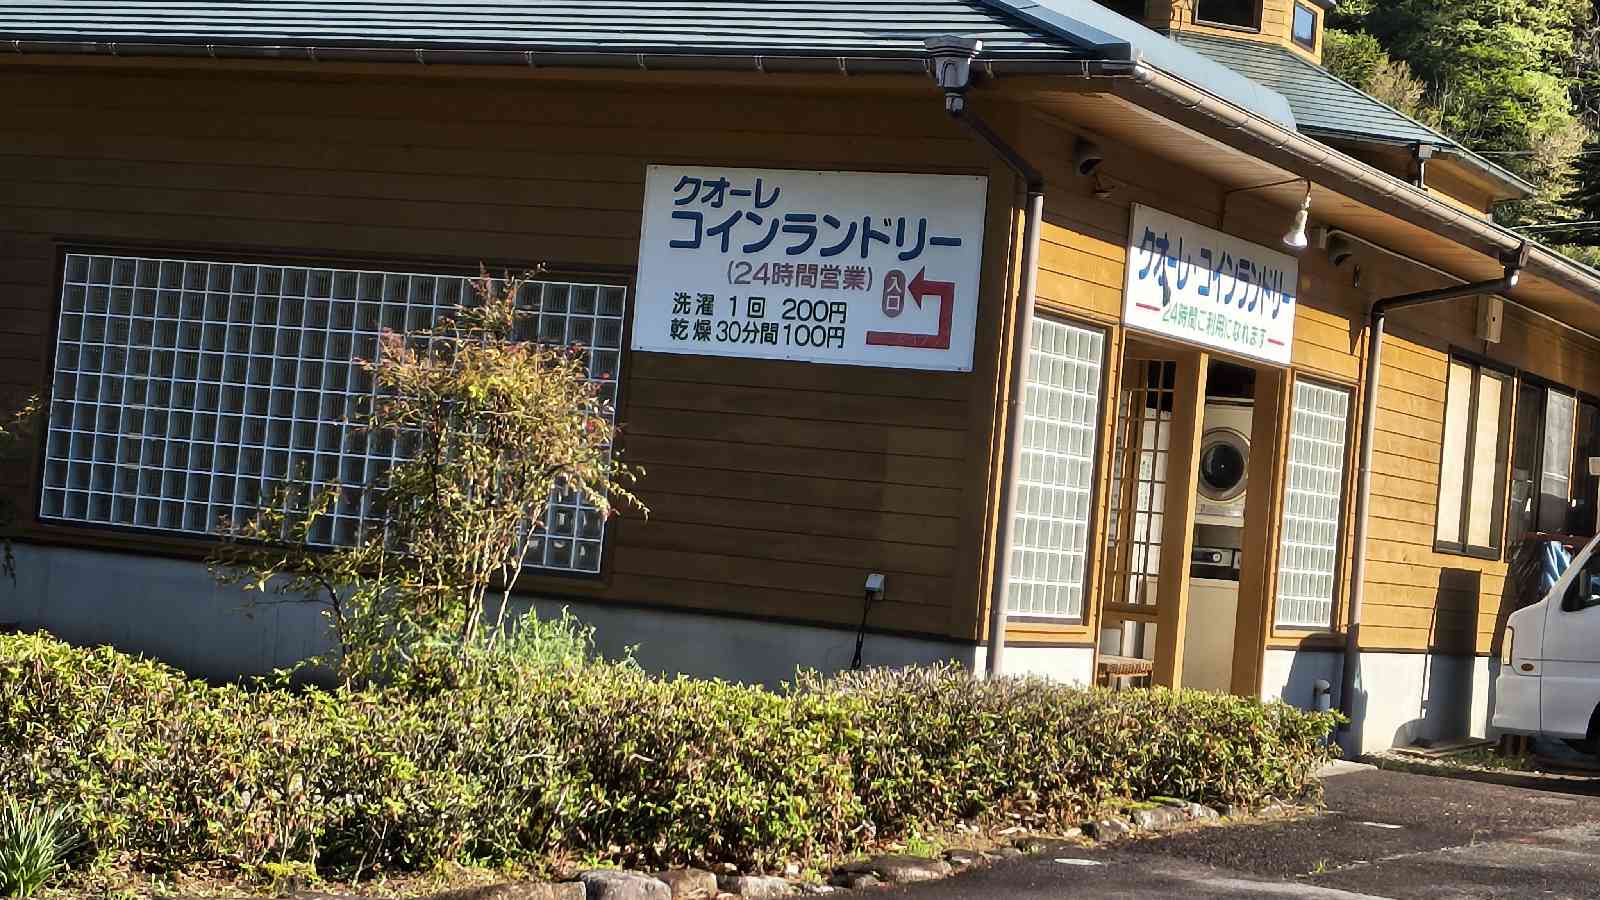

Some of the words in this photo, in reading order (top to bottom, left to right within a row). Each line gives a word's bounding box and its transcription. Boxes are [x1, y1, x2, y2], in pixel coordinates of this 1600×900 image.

[673, 175, 781, 208] クオーレ
[669, 210, 962, 261] コインランドリー
[727, 260, 873, 292] (24時間営業)
[672, 291, 715, 316] 洗濯
[782, 298, 848, 324] 200円
[886, 275, 903, 312] 入口
